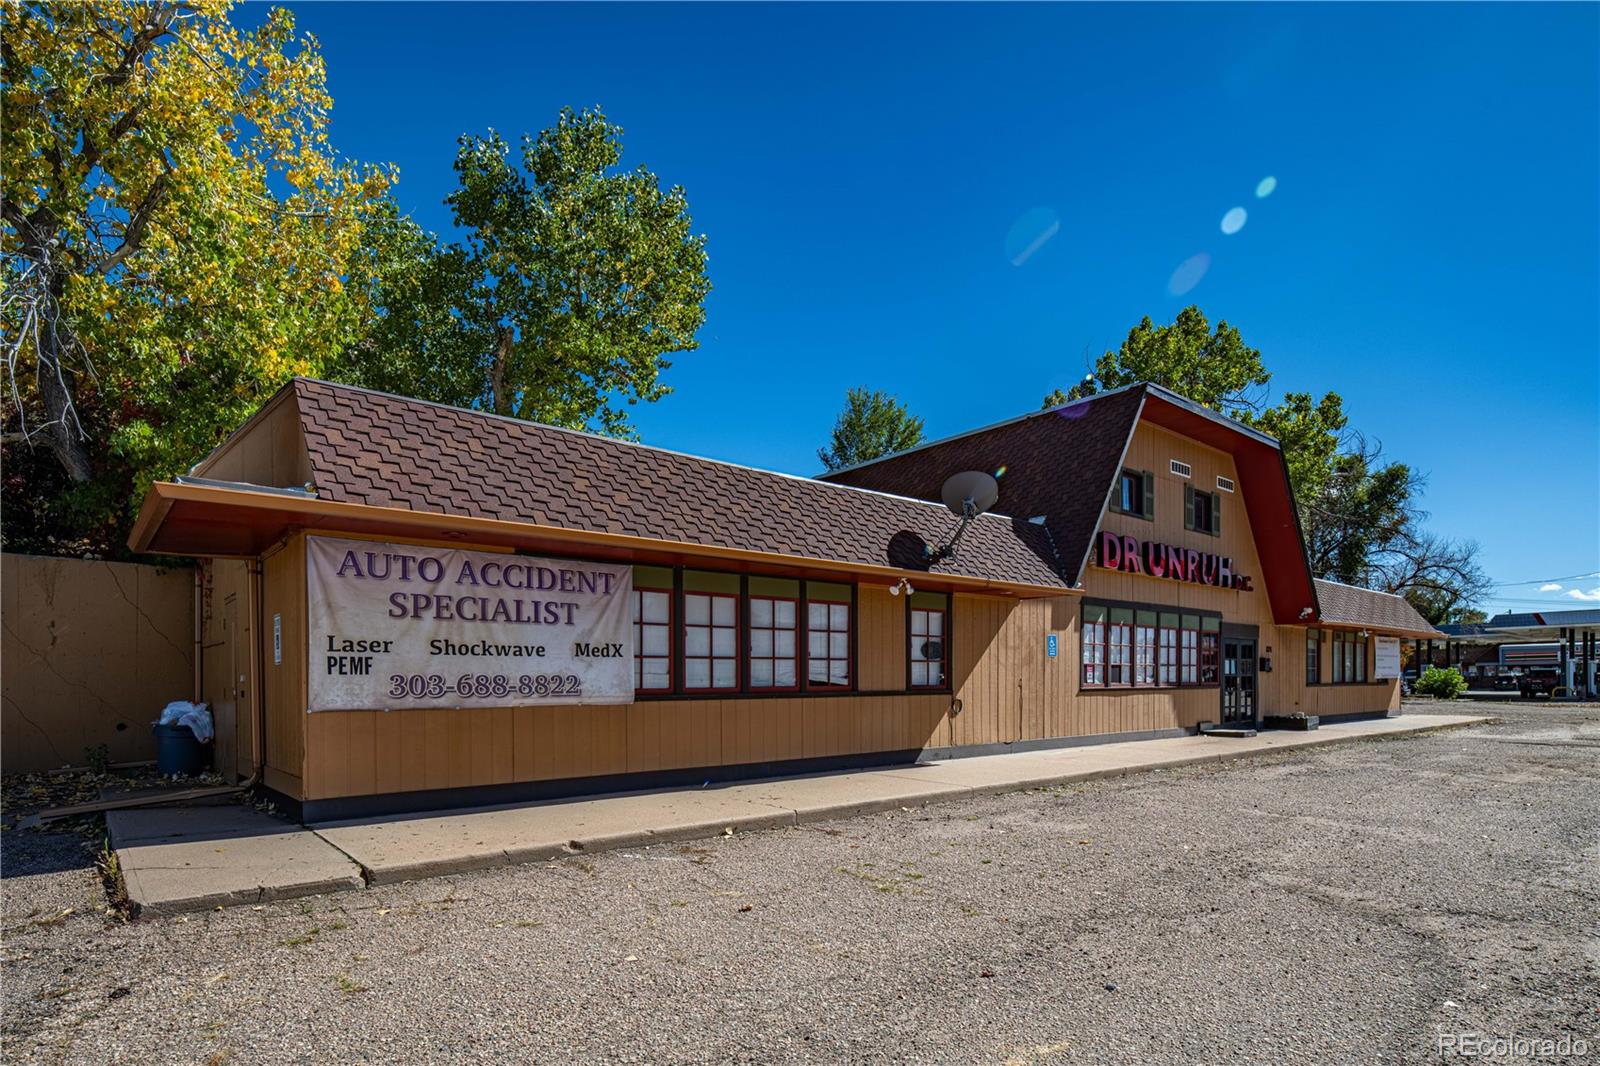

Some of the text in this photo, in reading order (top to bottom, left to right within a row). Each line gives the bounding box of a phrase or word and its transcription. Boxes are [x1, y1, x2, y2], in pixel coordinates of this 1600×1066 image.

[336, 550, 616, 595] AUTO ACCIDENT
[1098, 531, 1140, 573] DR
[1144, 541, 1232, 588] UNRUH
[387, 591, 579, 626] SPECIALIST
[327, 635, 624, 658] Laser Shockwave MedX
[327, 656, 373, 675] PEMF
[388, 673, 582, 698] 303-688-8822
